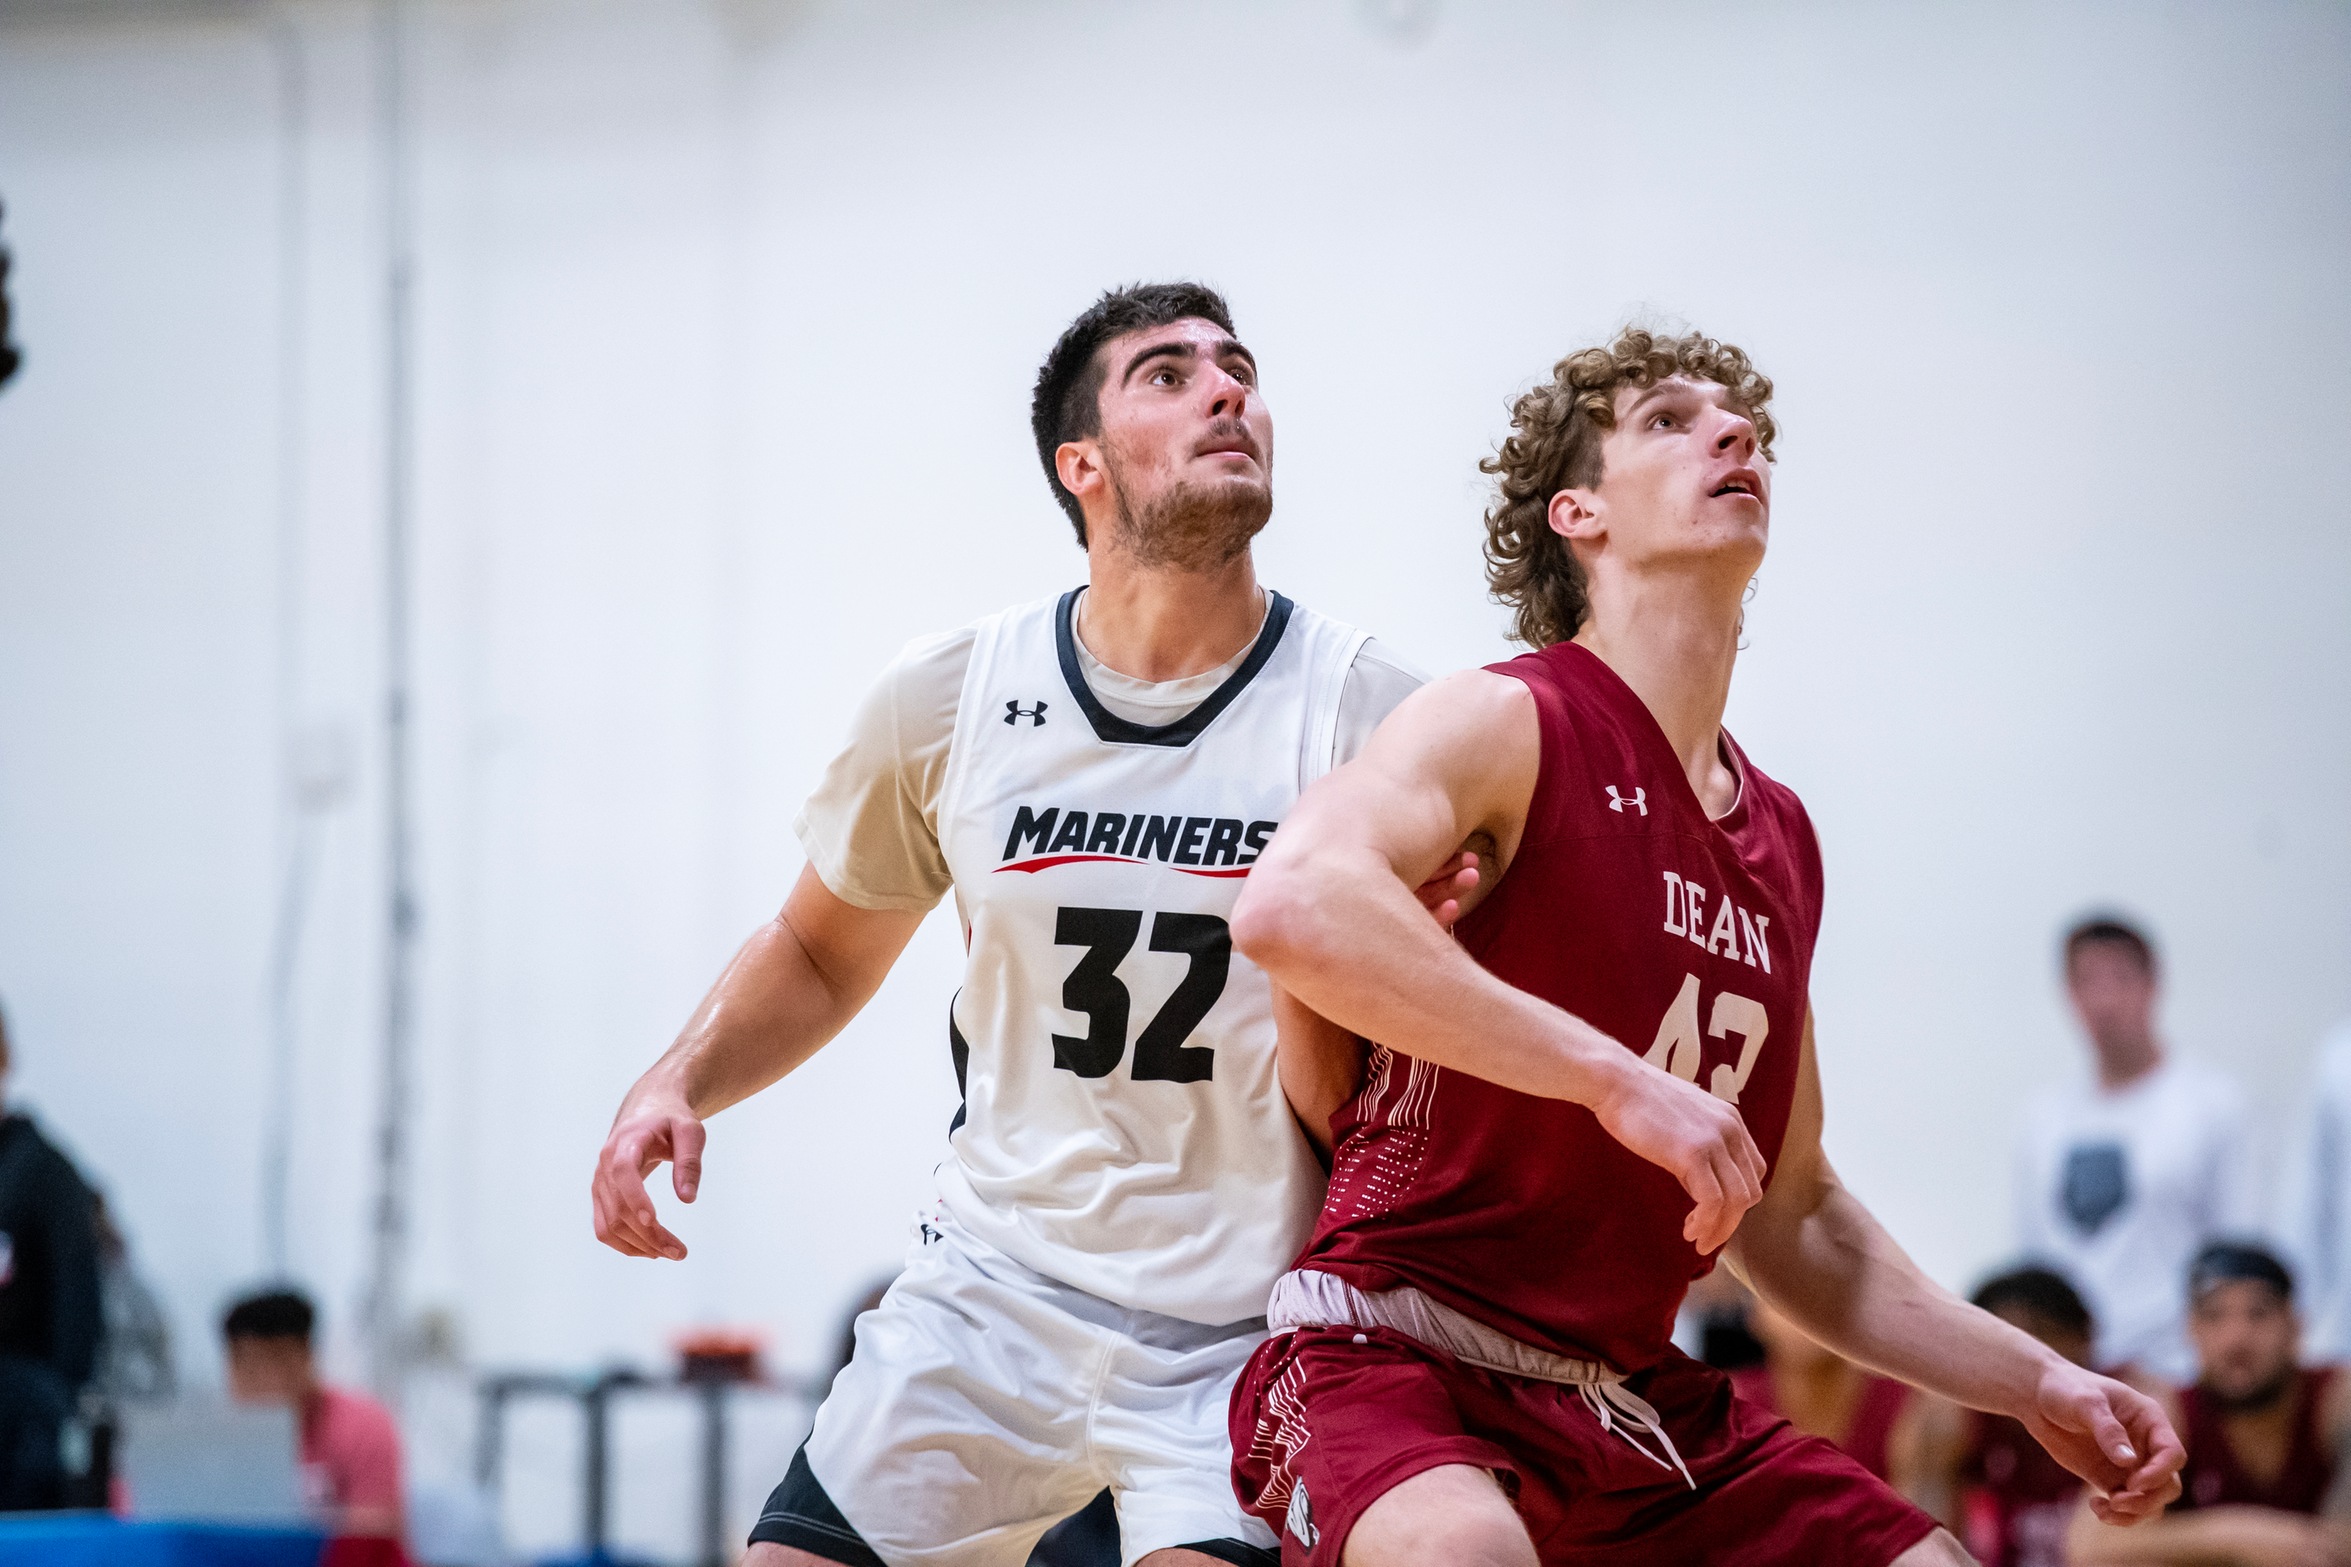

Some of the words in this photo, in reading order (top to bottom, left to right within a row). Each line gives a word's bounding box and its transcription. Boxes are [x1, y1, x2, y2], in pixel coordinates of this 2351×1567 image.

[1002, 806, 1278, 866] MARINERS
[1663, 871, 1771, 974] DEAN
[1051, 906, 1232, 1083] 32
